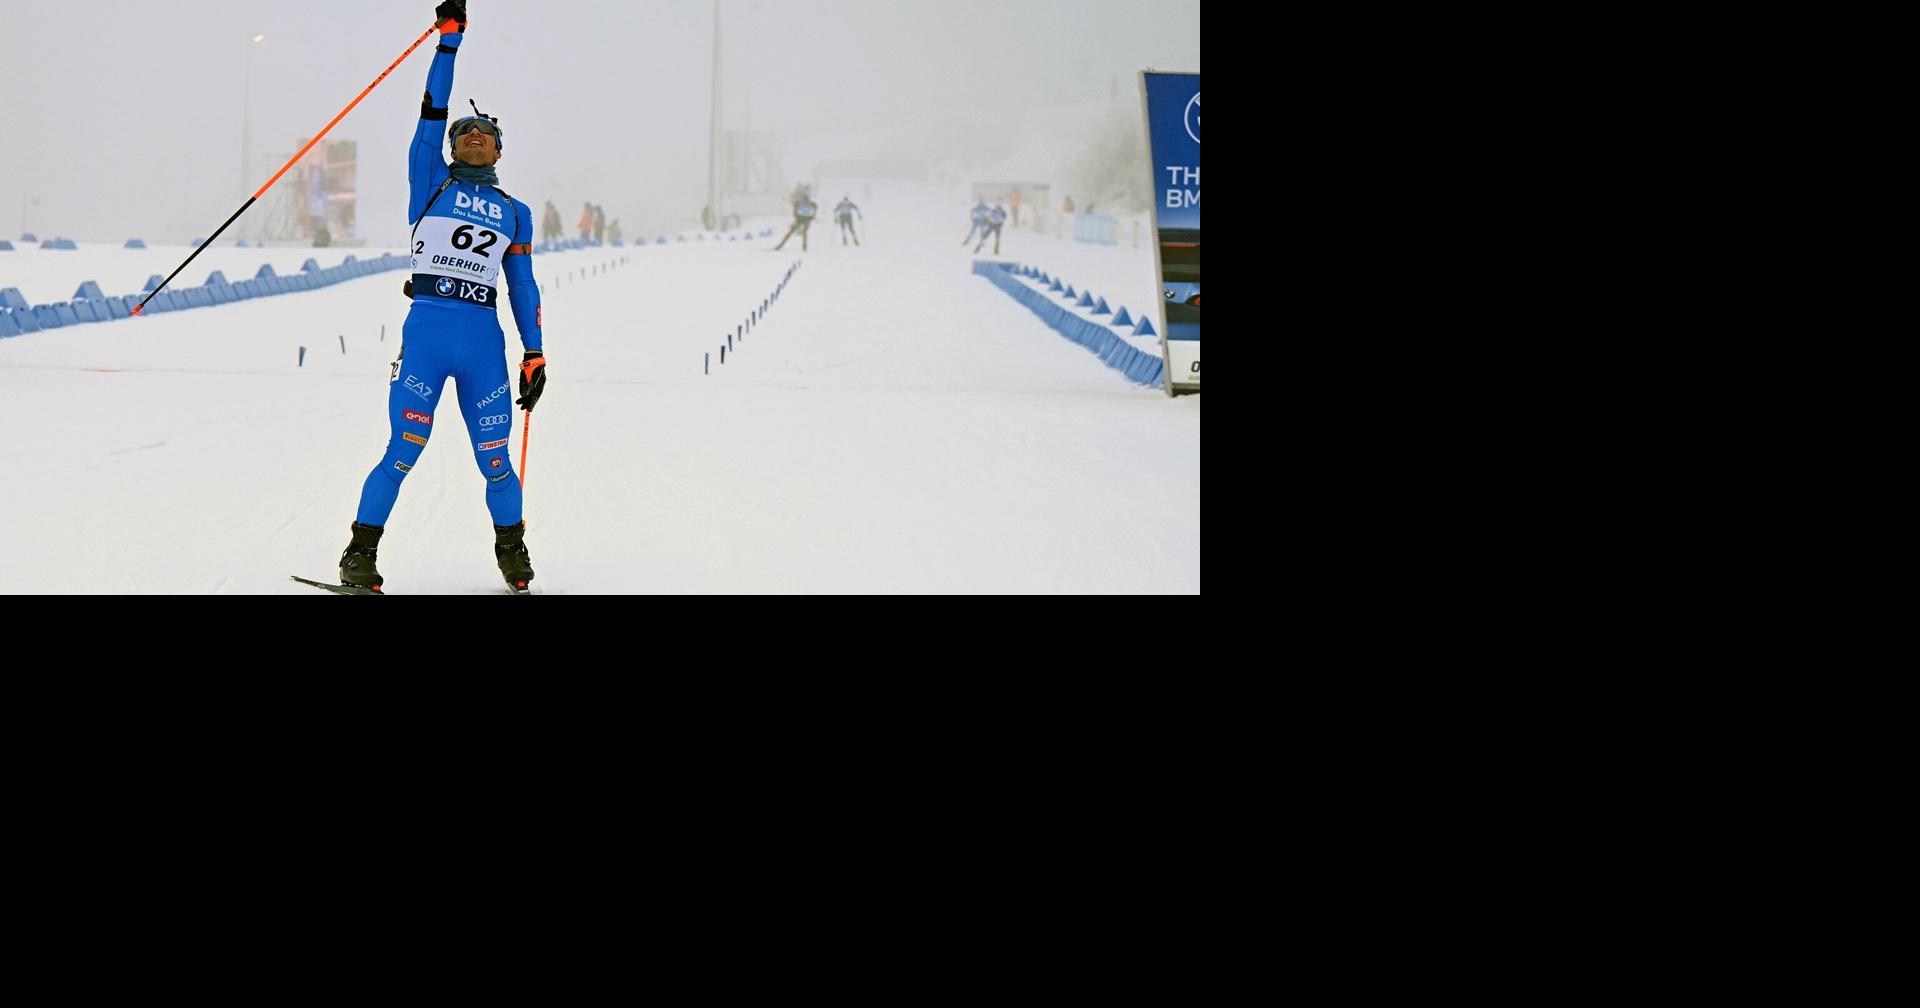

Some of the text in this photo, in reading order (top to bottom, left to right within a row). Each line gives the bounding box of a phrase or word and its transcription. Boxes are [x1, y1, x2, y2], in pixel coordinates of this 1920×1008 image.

[455, 191, 503, 220] DKB
[453, 208, 501, 228] Das kann Bank
[451, 225, 498, 258] 62
[432, 254, 487, 273] OBERHOF
[460, 282, 489, 302] iX3
[404, 374, 433, 397] EA7
[406, 412, 431, 424] enel
